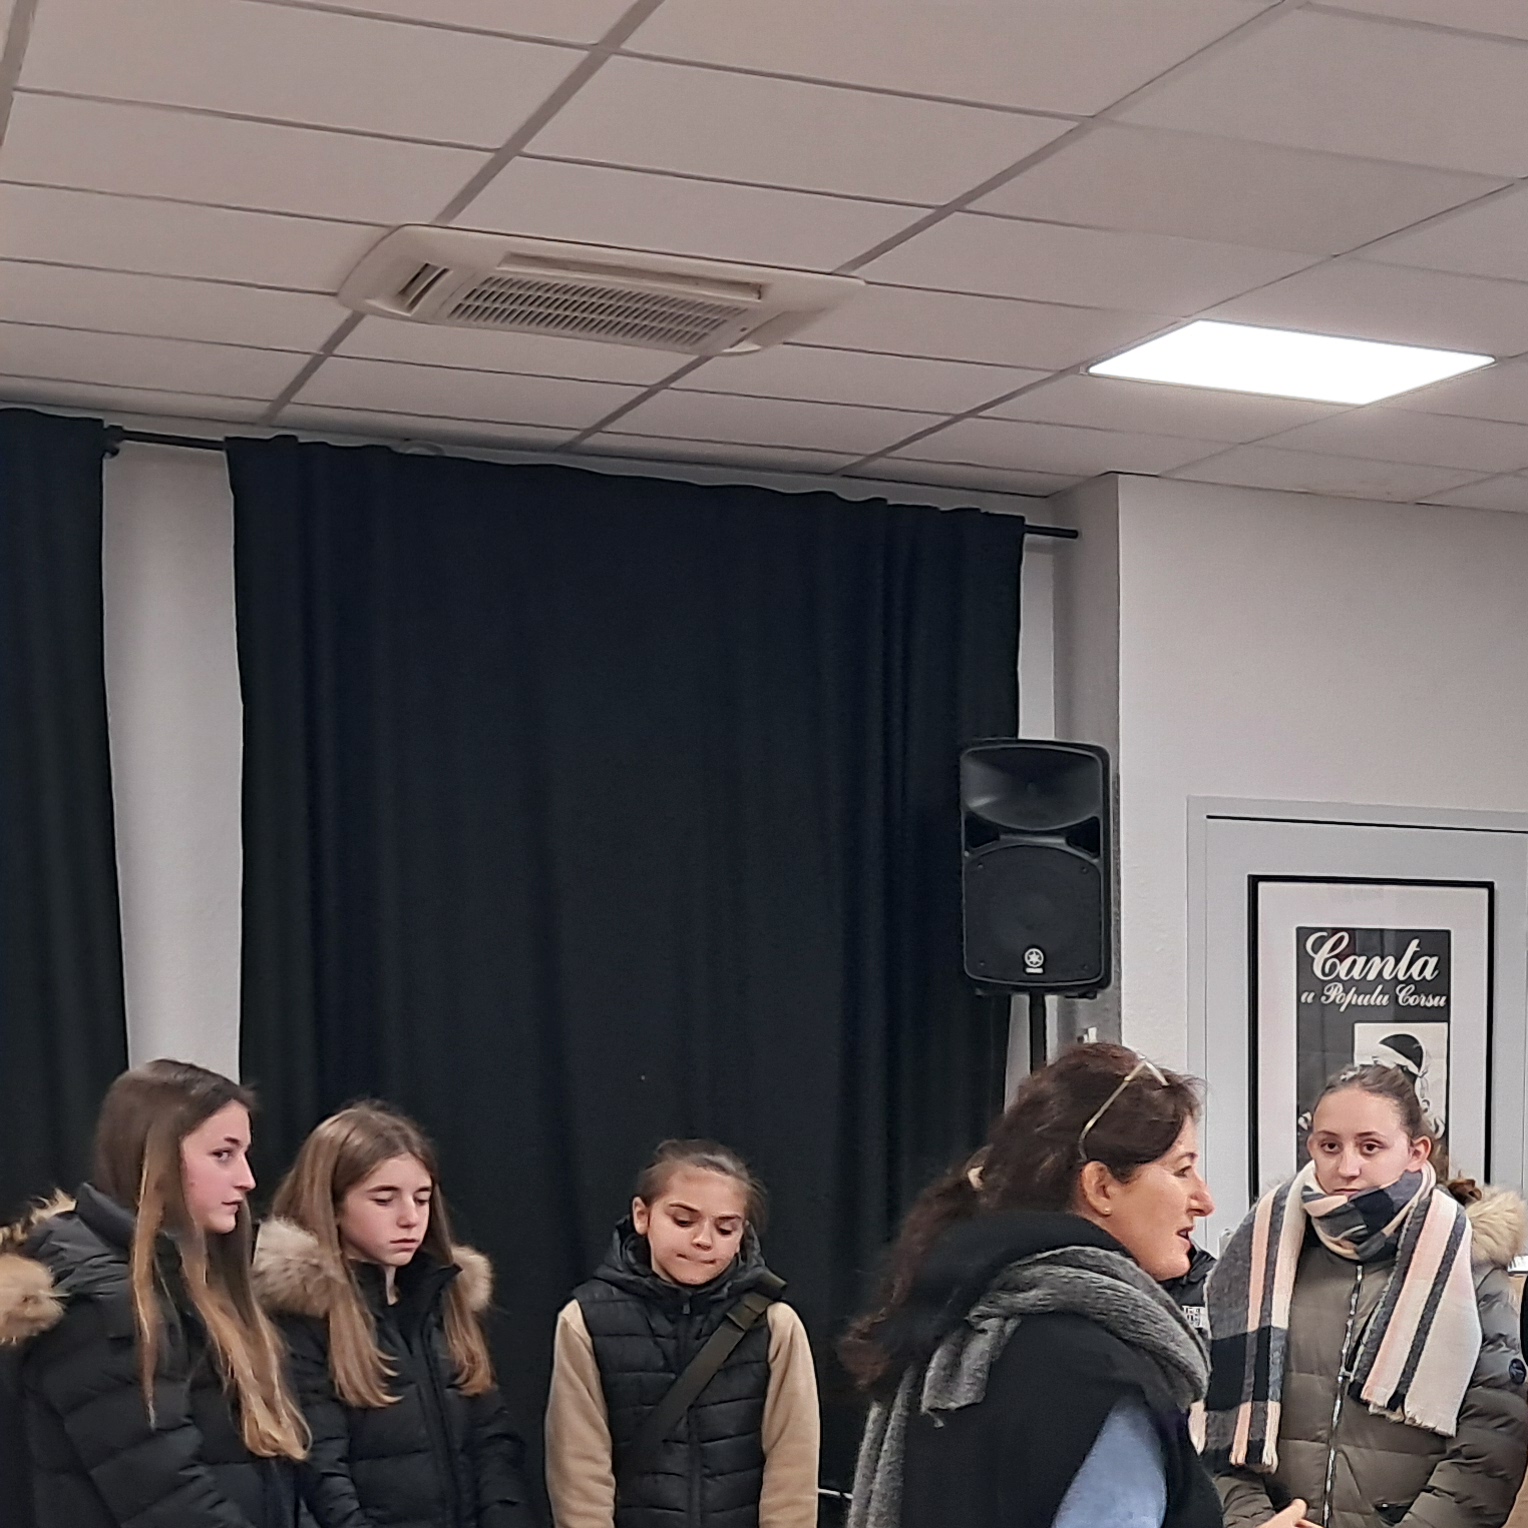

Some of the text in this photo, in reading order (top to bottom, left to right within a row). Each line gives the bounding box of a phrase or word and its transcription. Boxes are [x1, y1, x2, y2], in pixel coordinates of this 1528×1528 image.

[1305, 931, 1440, 982] Canta
[1321, 982, 1391, 1012] Populu
[1396, 983, 1447, 1008] Corsu
